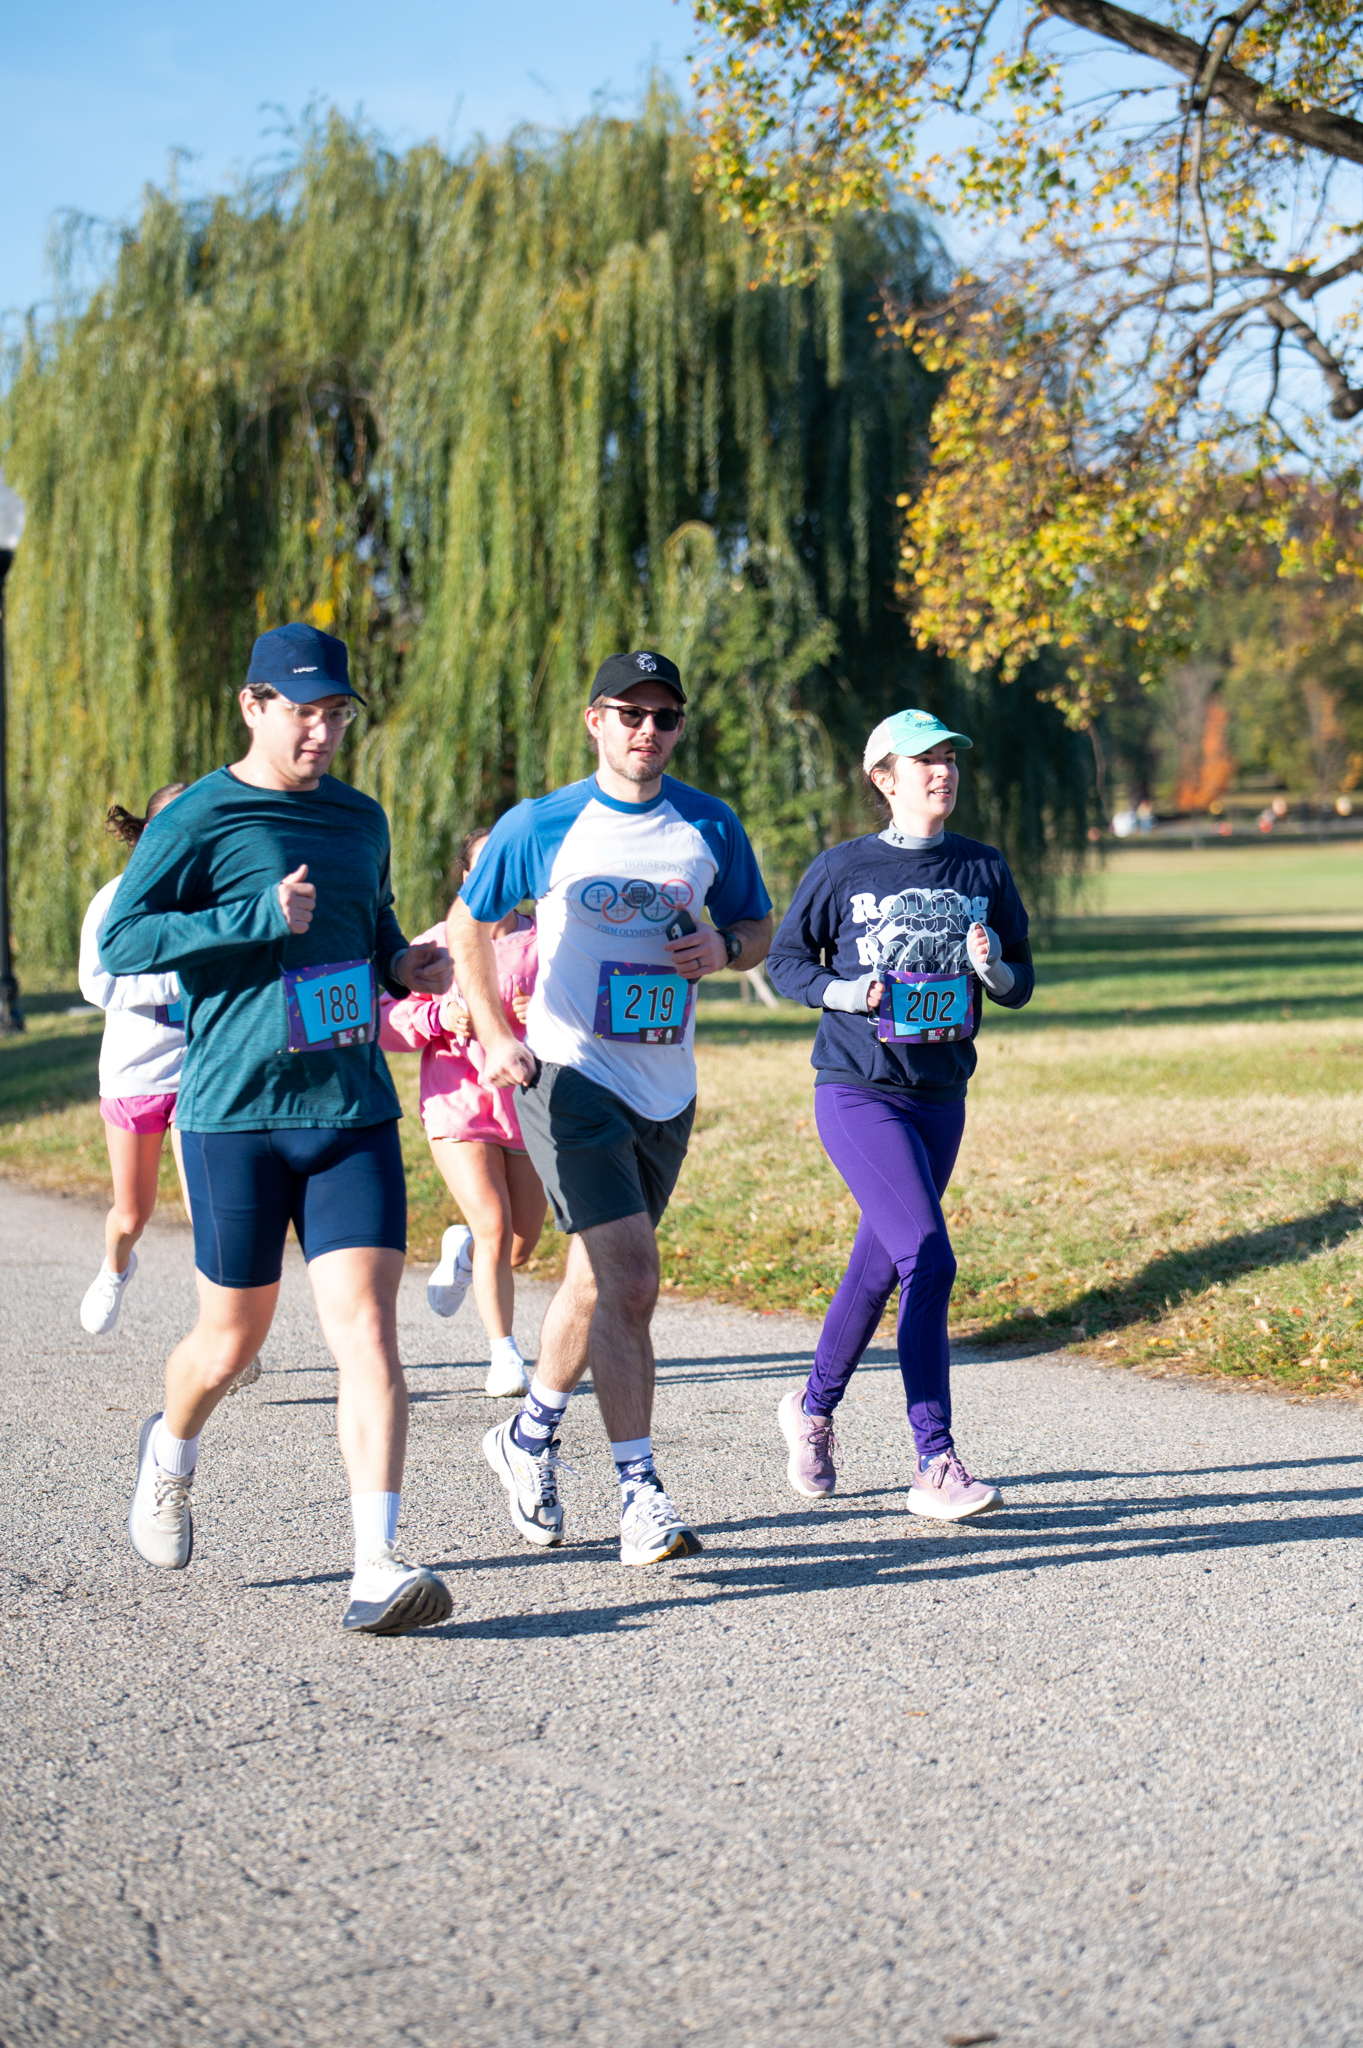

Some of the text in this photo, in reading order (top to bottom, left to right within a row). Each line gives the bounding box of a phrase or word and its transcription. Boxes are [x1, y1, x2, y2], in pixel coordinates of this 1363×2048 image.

[596, 923, 618, 935] FIRM
[619, 927, 661, 937] OLYMPICS
[313, 983, 360, 1027] 188
[623, 983, 676, 1024] 219
[905, 990, 957, 1023] 202
